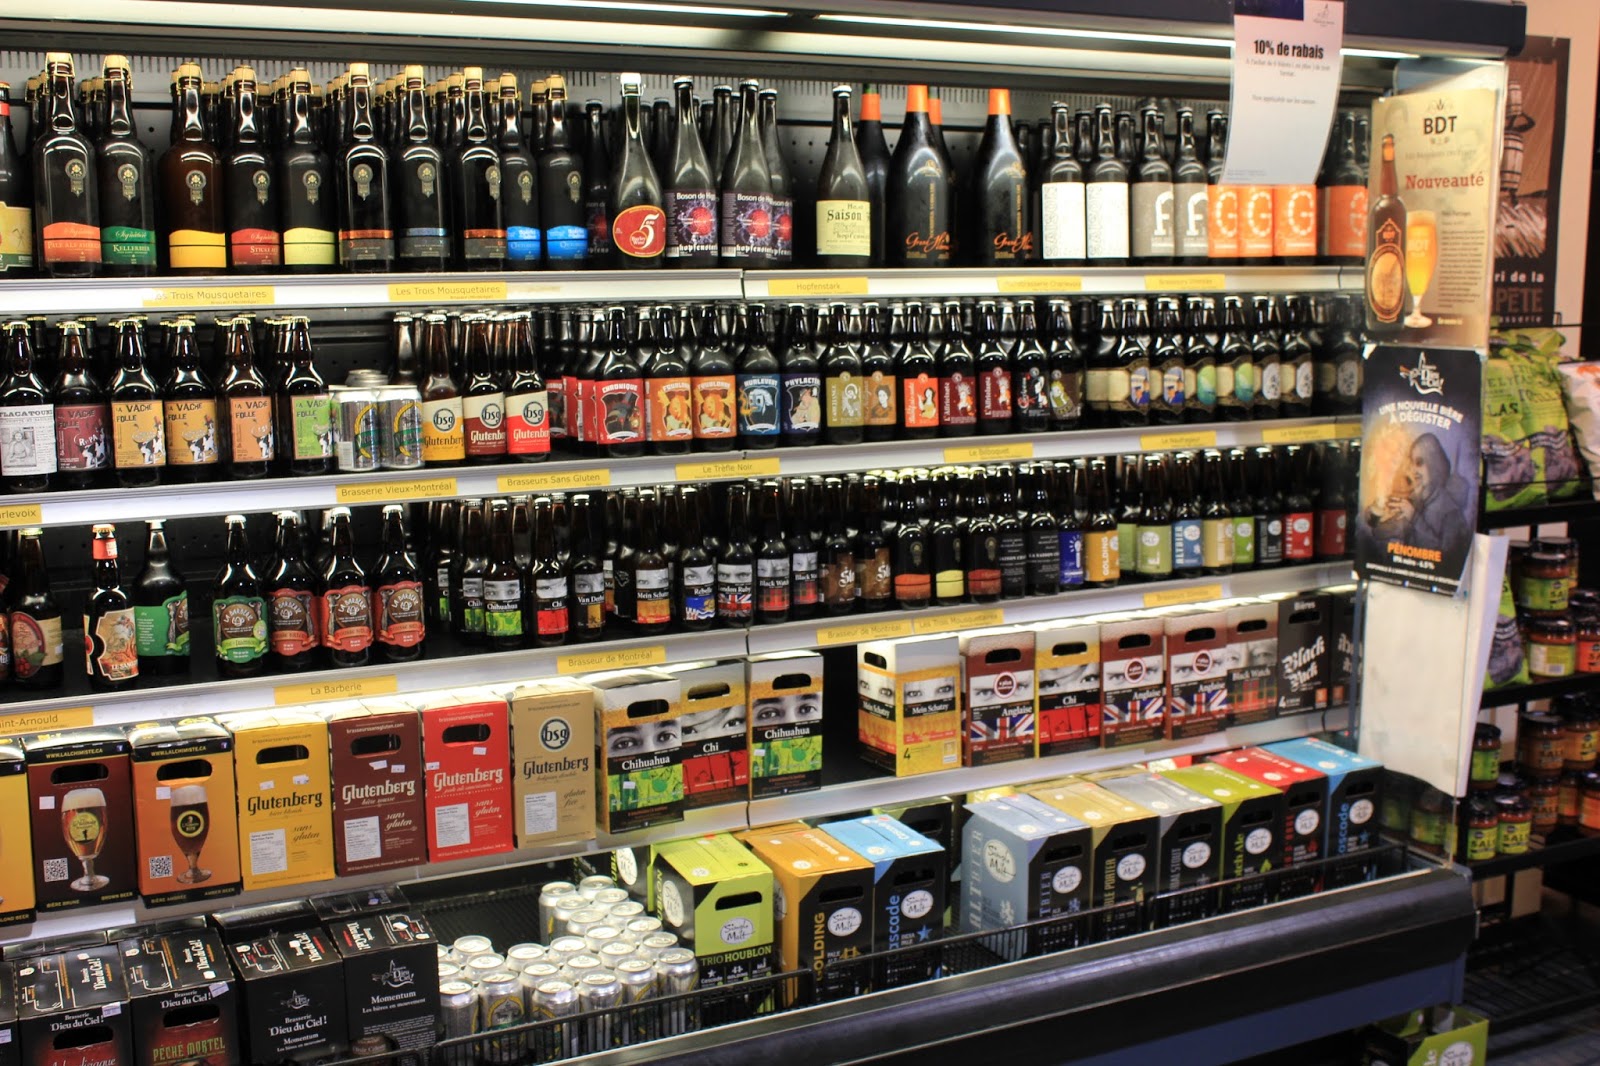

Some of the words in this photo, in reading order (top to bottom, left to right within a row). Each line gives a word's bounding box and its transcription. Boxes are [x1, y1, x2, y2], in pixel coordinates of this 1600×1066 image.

[1254, 40, 1274, 55] 10%
[1277, 42, 1289, 56] de
[1292, 44, 1324, 59] rabais
[1424, 116, 1457, 135] BDT
[1405, 172, 1484, 189] Nouveauté
[697, 192, 705, 200] de
[827, 209, 862, 222] Saison
[1154, 191, 1174, 235] F
[1186, 191, 1208, 235] F
[1215, 191, 1238, 237] G
[1248, 191, 1272, 237] G
[1288, 190, 1314, 236] G
[639, 213, 660, 248] 5
[1510, 272, 1526, 282] de
[1532, 272, 1544, 282] la
[396, 287, 411, 296] Les
[414, 286, 435, 295] Trois
[438, 285, 500, 296] Mousquetaires
[796, 282, 841, 292] Hopfenstark
[170, 292, 194, 300] Trois
[197, 290, 267, 301] Mousquetaires
[1379, 403, 1396, 415] UNE
[1397, 400, 1438, 413] NOUVELLE
[1440, 405, 1463, 423] BIÈRE
[1399, 409, 1451, 430] DÉGUSTER
[714, 464, 735, 472] Trèfle
[738, 463, 752, 471] Noir
[507, 476, 548, 487] Brasseurs
[550, 474, 570, 484] Sans
[573, 474, 600, 482] Gluten
[341, 487, 383, 496] Brasserie
[386, 482, 452, 494] Vieux-Montréal
[1387, 541, 1441, 562] PÉNOMBRE
[487, 602, 518, 610] Chihuahua
[828, 629, 858, 639] Brasseur
[568, 657, 602, 667] Brasseur
[618, 650, 652, 661] Montréal
[311, 687, 321, 696] La
[324, 683, 362, 693] Barberie
[1198, 682, 1226, 692] Anglaise
[1062, 696, 1077, 706] Chi
[1133, 689, 1162, 700] Anglaise
[1279, 696, 1286, 708] 4
[912, 706, 926, 714] Mein
[1002, 706, 1033, 717] Anglaise
[542, 722, 569, 746] bsg
[764, 726, 810, 739] Chihuahua
[46, 749, 103, 759] WWW.LALCHIMISTE.CA
[151, 746, 206, 757] WWW.LALCHIMISTE.CA
[702, 742, 719, 753] Chi
[903, 748, 911, 760] 4
[523, 757, 589, 780] Glutenberg
[621, 754, 670, 771] Chihuahua
[433, 768, 503, 792] Glutenberg
[342, 780, 415, 805] Glutenberg
[563, 789, 587, 798] gluten
[248, 791, 322, 816] Glutenberg
[386, 812, 405, 820] sans
[475, 806, 500, 817] gluten
[386, 820, 412, 831] gluten
[1338, 803, 1349, 854] ascade
[293, 832, 320, 842] gluten
[1234, 833, 1244, 850] Ale
[969, 830, 984, 930] ALTBIER
[1104, 858, 1116, 891] PORTER
[885, 895, 900, 961] ascade
[700, 956, 723, 966] TRIO
[725, 946, 772, 963] HOUBLON
[174, 990, 198, 998] Brasserie
[371, 991, 417, 1004] Momentum
[161, 999, 181, 1009] Dieu
[182, 997, 192, 1006] du
[193, 994, 207, 1003] Ciel
[397, 998, 426, 1008] mouvement
[64, 1012, 89, 1021] Brasserie
[285, 1013, 312, 1024] Brasserie
[51, 1020, 71, 1031] Dieu
[72, 1019, 82, 1028] du
[83, 1017, 99, 1026] Ciel
[269, 1025, 292, 1036] Dieu
[293, 1022, 304, 1031] du
[306, 1018, 322, 1028] Ciel
[283, 1032, 319, 1046] Momentum
[153, 1043, 183, 1060] PÉCHÉ
[187, 1037, 225, 1055] MORTEL
